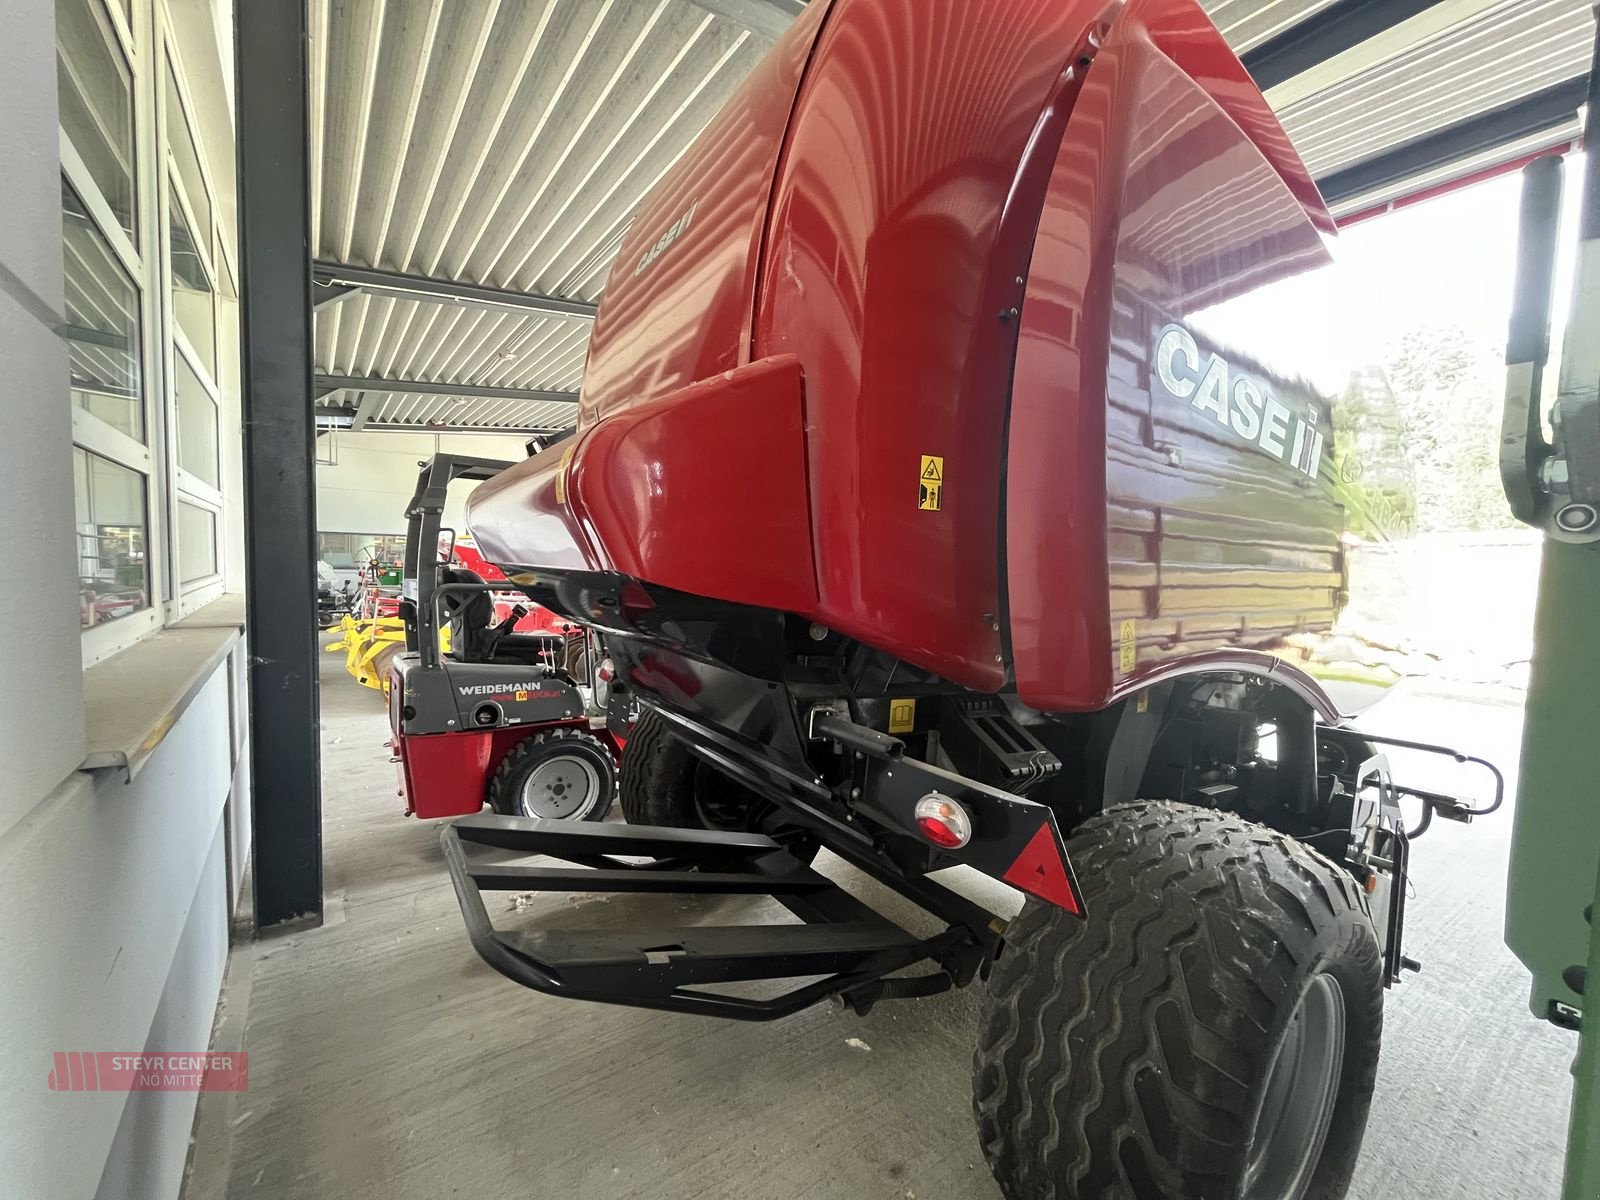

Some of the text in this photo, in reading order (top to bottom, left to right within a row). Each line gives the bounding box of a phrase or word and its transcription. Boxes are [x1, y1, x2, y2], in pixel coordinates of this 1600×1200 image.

[634, 219, 681, 277] CASE
[1156, 324, 1291, 460] CASE
[458, 681, 541, 696] WEIDEMANN
